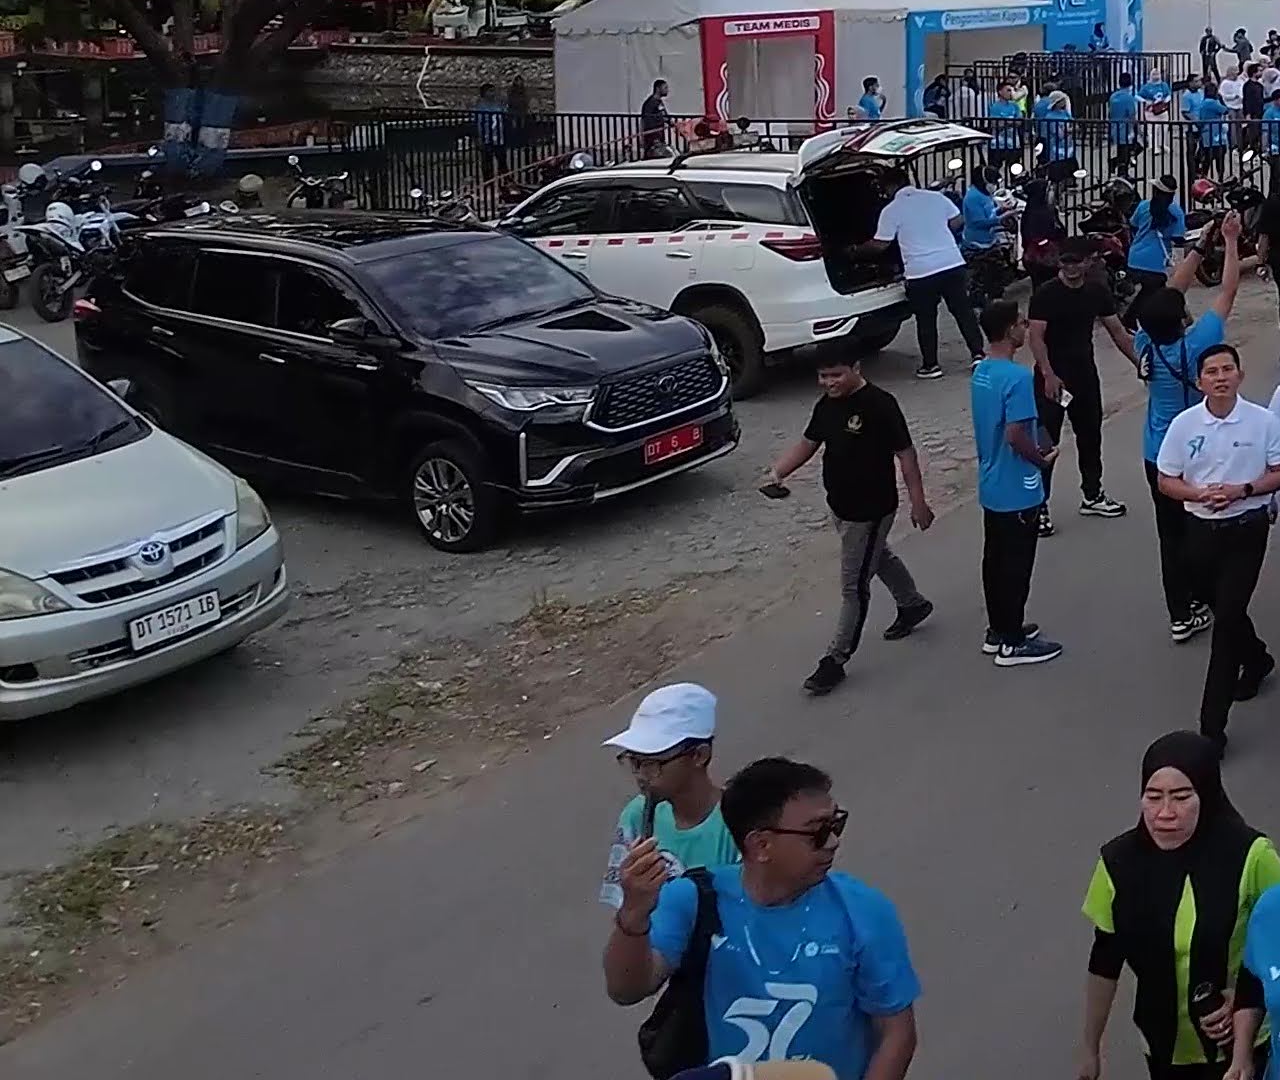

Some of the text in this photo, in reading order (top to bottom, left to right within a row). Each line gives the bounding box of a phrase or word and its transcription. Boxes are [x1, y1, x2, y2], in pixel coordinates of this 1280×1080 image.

[734, 19, 811, 33] TEAM MEDIS
[648, 442, 661, 456] DT
[671, 435, 679, 448] 6
[135, 616, 152, 639] DT
[157, 603, 193, 631] 1571
[198, 595, 216, 616] IB
[722, 981, 818, 1062] 57
